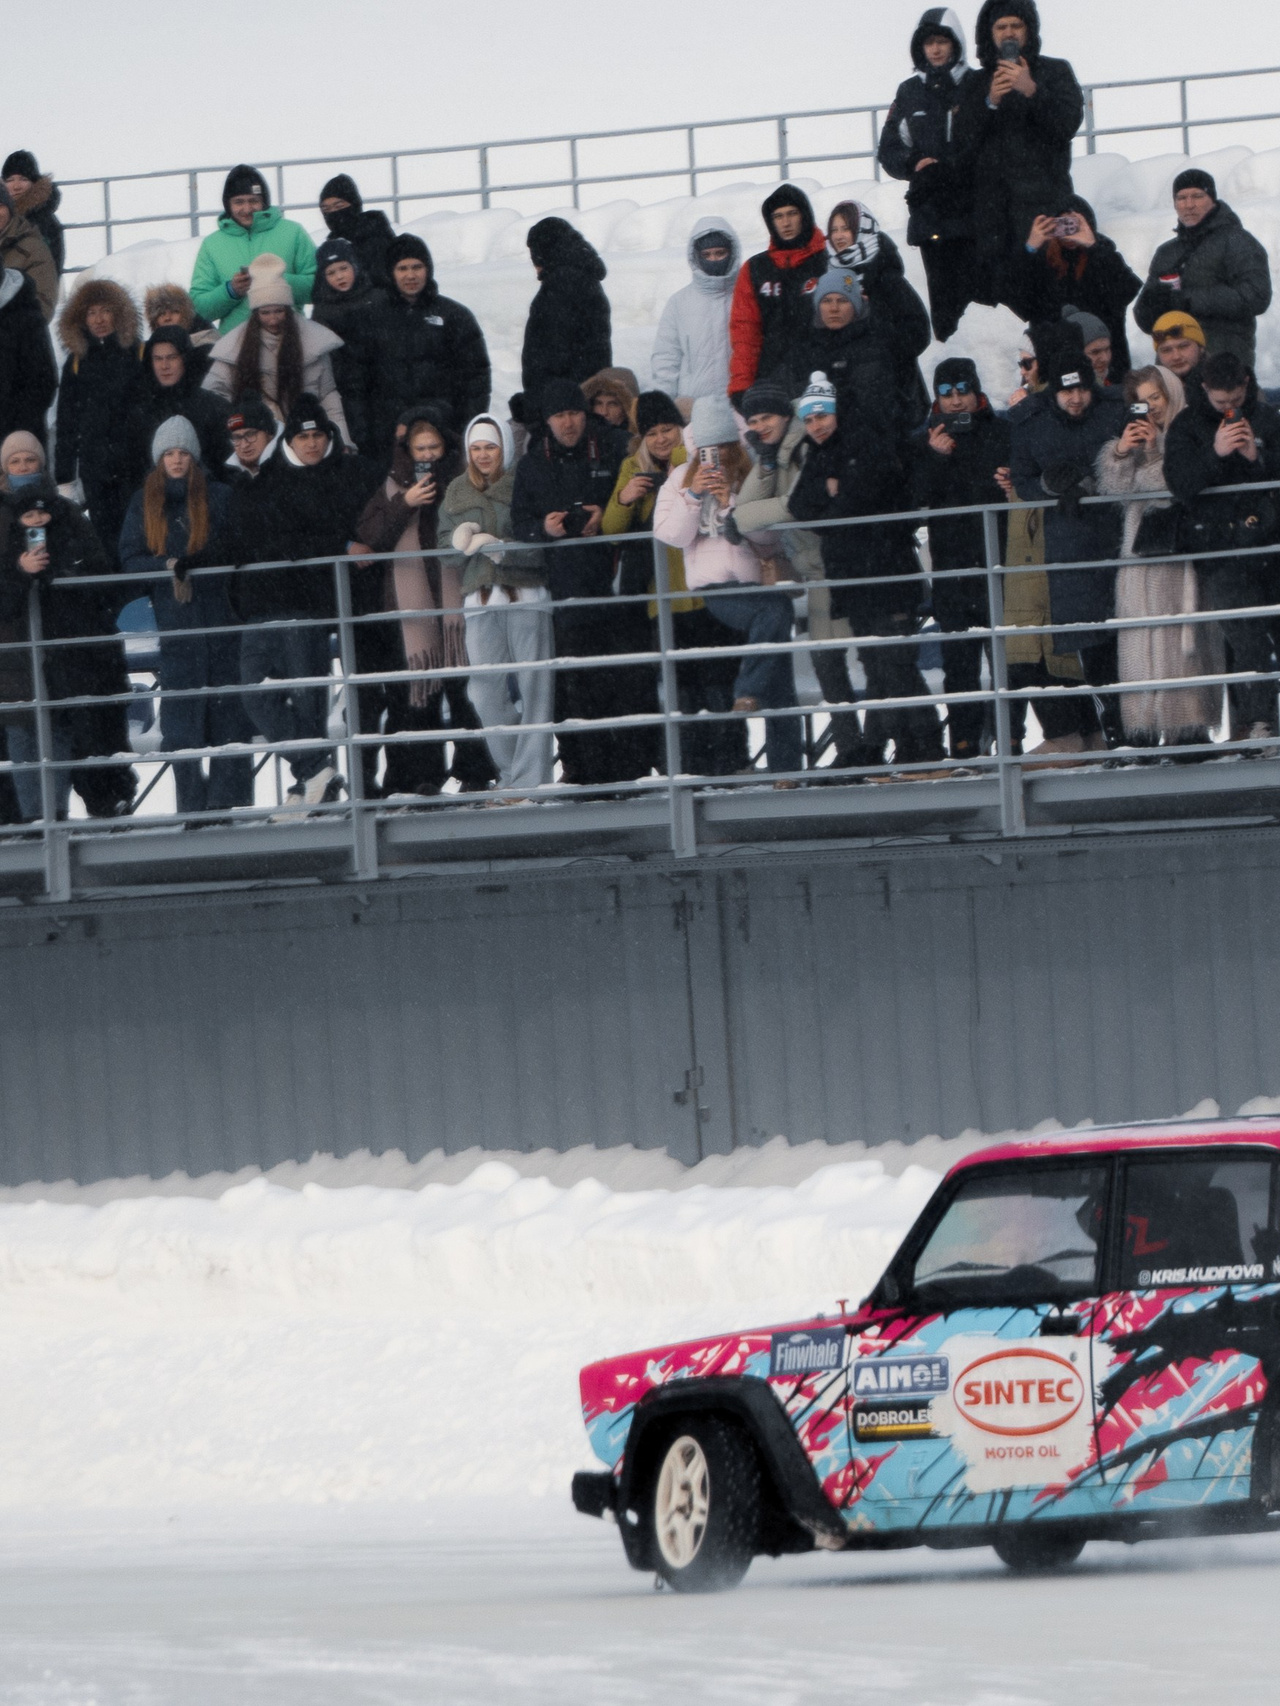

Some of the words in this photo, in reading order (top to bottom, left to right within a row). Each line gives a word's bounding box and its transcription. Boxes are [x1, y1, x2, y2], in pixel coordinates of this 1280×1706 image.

[774, 1338, 839, 1371] Finwhale
[855, 1362, 947, 1391] AIMOL
[963, 1378, 1075, 1406] SINTEC
[857, 1409, 931, 1427] DOBROLE
[985, 1446, 1034, 1459] MOTOR
[1038, 1445, 1060, 1458] OIL
